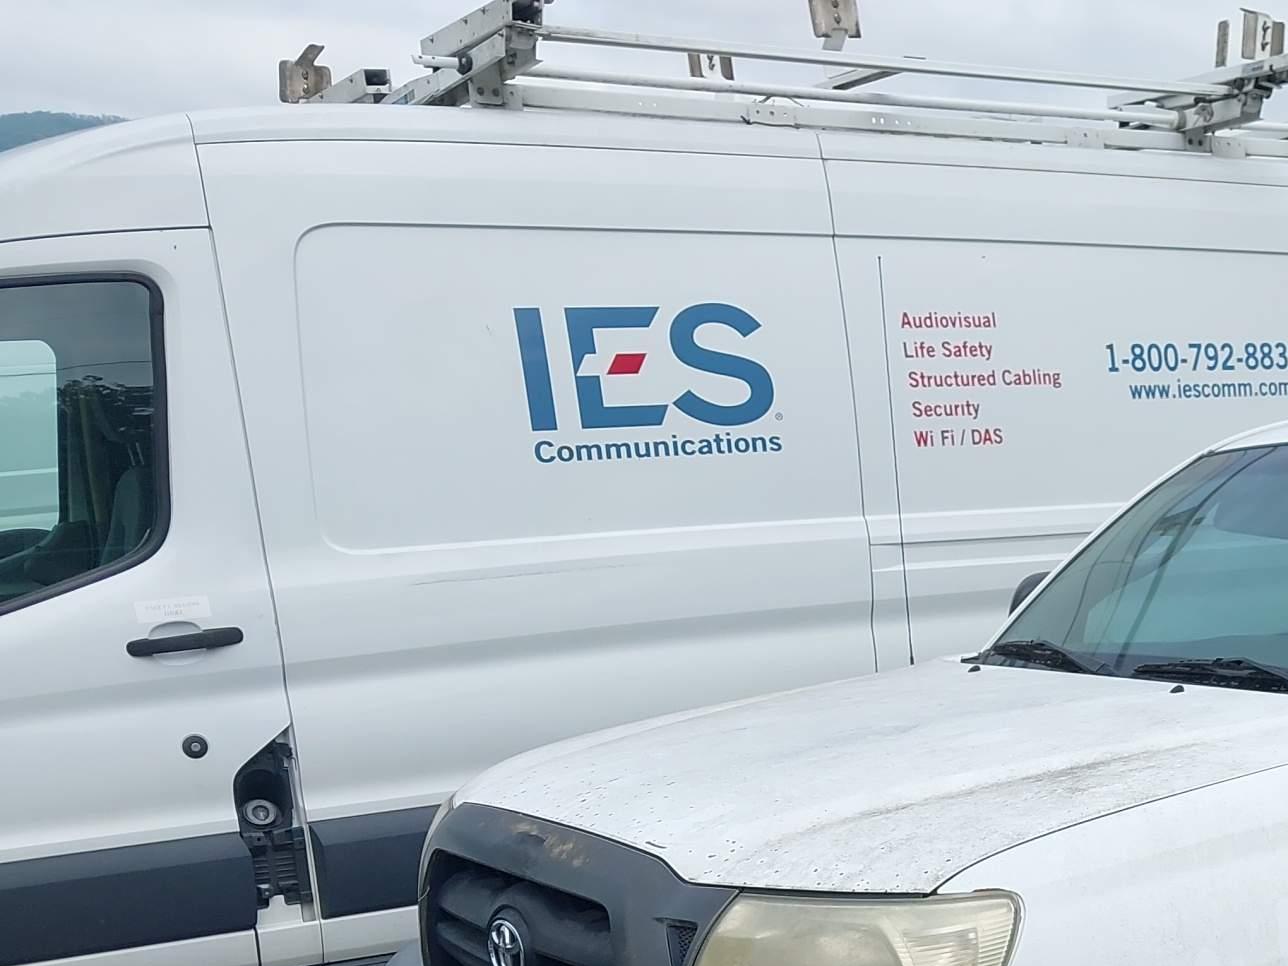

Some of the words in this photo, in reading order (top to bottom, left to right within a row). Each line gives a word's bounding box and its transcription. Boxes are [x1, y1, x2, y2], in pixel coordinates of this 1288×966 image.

[900, 311, 997, 329] Audiovisual
[903, 342, 936, 358] Life
[941, 340, 993, 361] Safety
[513, 302, 775, 432] IES
[908, 370, 997, 388] Structured
[1001, 368, 1062, 389] Cabling
[911, 400, 980, 420] Security
[533, 432, 783, 464] Communications
[913, 430, 934, 447] Wi
[940, 429, 955, 447] Fi
[971, 428, 1004, 446] DAS
